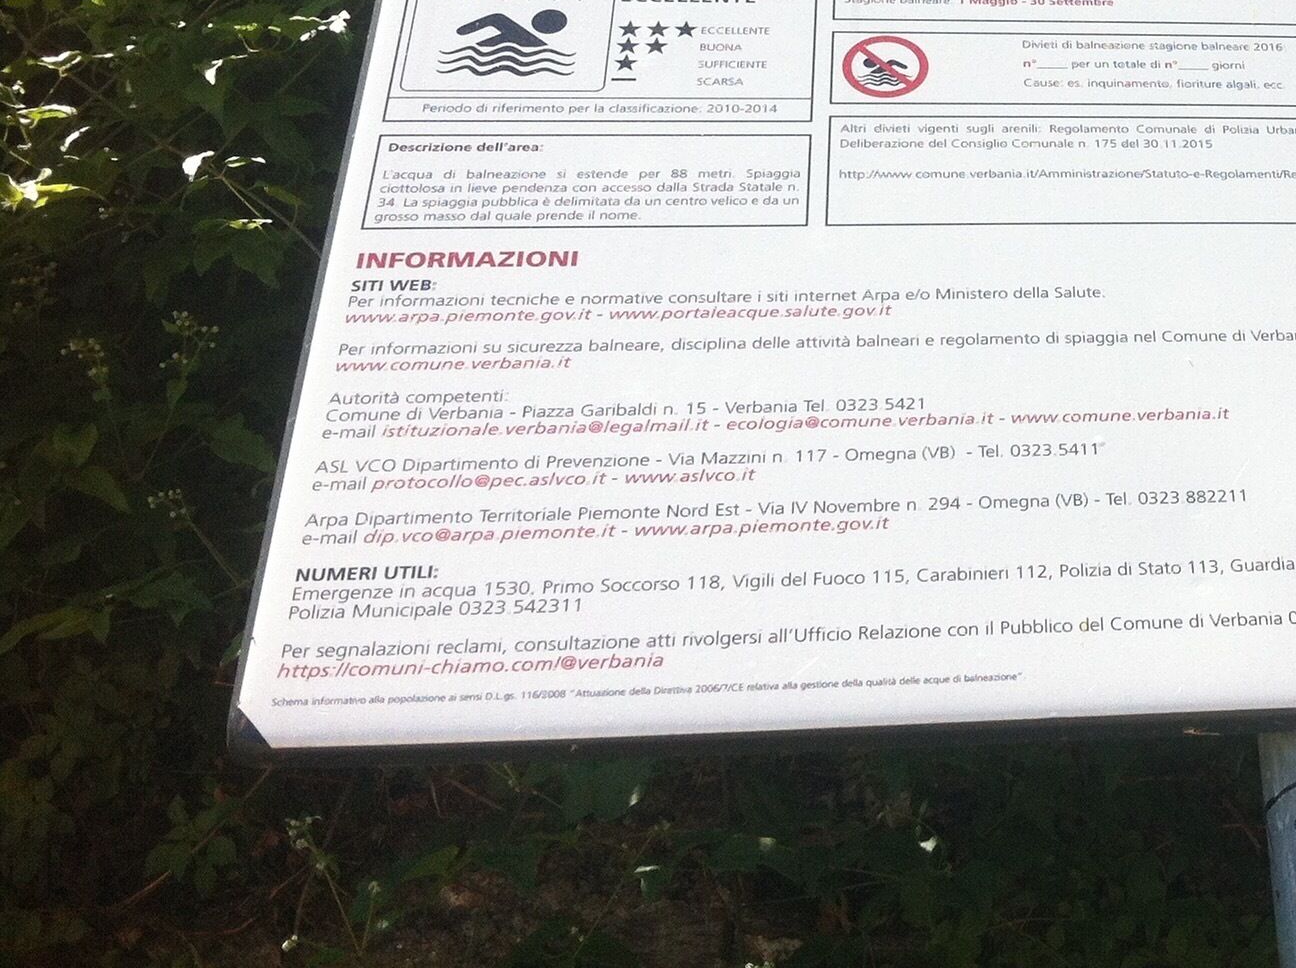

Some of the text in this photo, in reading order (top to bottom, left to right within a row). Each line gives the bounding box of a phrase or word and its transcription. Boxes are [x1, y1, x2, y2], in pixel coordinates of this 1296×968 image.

[700, 26, 770, 36] ECCELLENTE
[699, 42, 742, 52] BUONA
[1022, 39, 1283, 53] Divieti di balneazione stagione balneare 2016
[698, 60, 768, 69] SUFFICIENTE
[696, 76, 744, 87] SCARSA
[422, 103, 473, 113] Periodo
[475, 103, 488, 113] di
[492, 102, 565, 114] riferimento
[568, 105, 590, 115] per
[594, 103, 605, 114] la
[706, 103, 778, 114] 2010-2014
[388, 142, 473, 153] Descrizione
[379, 183, 446, 194] ciottolosa
[450, 185, 463, 193] in
[467, 183, 498, 194] lieve
[501, 182, 568, 194] pendenza
[571, 184, 597, 193] con
[601, 184, 652, 193] accesso
[656, 182, 688, 193] dalla
[692, 181, 734, 193] Strada
[739, 181, 783, 192] Statale
[373, 209, 641, 224] grosso masso dal quale prende il nome.
[355, 250, 579, 269] INFORMAZIONI
[350, 279, 437, 292] SITI WEB:
[347, 286, 1105, 308] Per informazioni tecniche e normative consultare i siti internet Arpa e/o Ministero della Salute.
[338, 343, 366, 356] Per
[370, 341, 477, 356] informazioni
[482, 343, 502, 354] su
[507, 342, 583, 354] sicurezza
[588, 338, 664, 353] balneare,
[671, 337, 747, 353] disciplina
[752, 336, 791, 350] delle
[795, 335, 851, 349] attività
[856, 334, 919, 348] balneari
[924, 336, 935, 346] e
[940, 333, 1040, 349] regolamento
[1045, 332, 1060, 344] di
[1064, 333, 1129, 347] spiaggia
[1133, 330, 1157, 343] nel
[1161, 330, 1228, 343] Comune
[1232, 329, 1246, 342] di
[329, 391, 400, 406] Autorità
[291, 586, 394, 603] Emergenze
[399, 587, 416, 599] in
[421, 585, 477, 600] acqua
[542, 579, 594, 594] Primo
[600, 578, 680, 593] Soccorso
[688, 574, 725, 592] 118,
[732, 572, 774, 591] Vigili
[780, 571, 807, 587] del
[813, 571, 866, 586] Fuoco
[872, 568, 909, 585] 115,
[916, 566, 1009, 583] Carabinieri
[1016, 564, 1053, 581] 112,
[1059, 563, 1112, 578] Polizia
[1117, 562, 1132, 577] di
[1138, 561, 1182, 576] Stato
[1188, 559, 1224, 575] 113,
[1230, 557, 1295, 573] Guardia
[295, 565, 439, 582] NUMERI UTILI:
